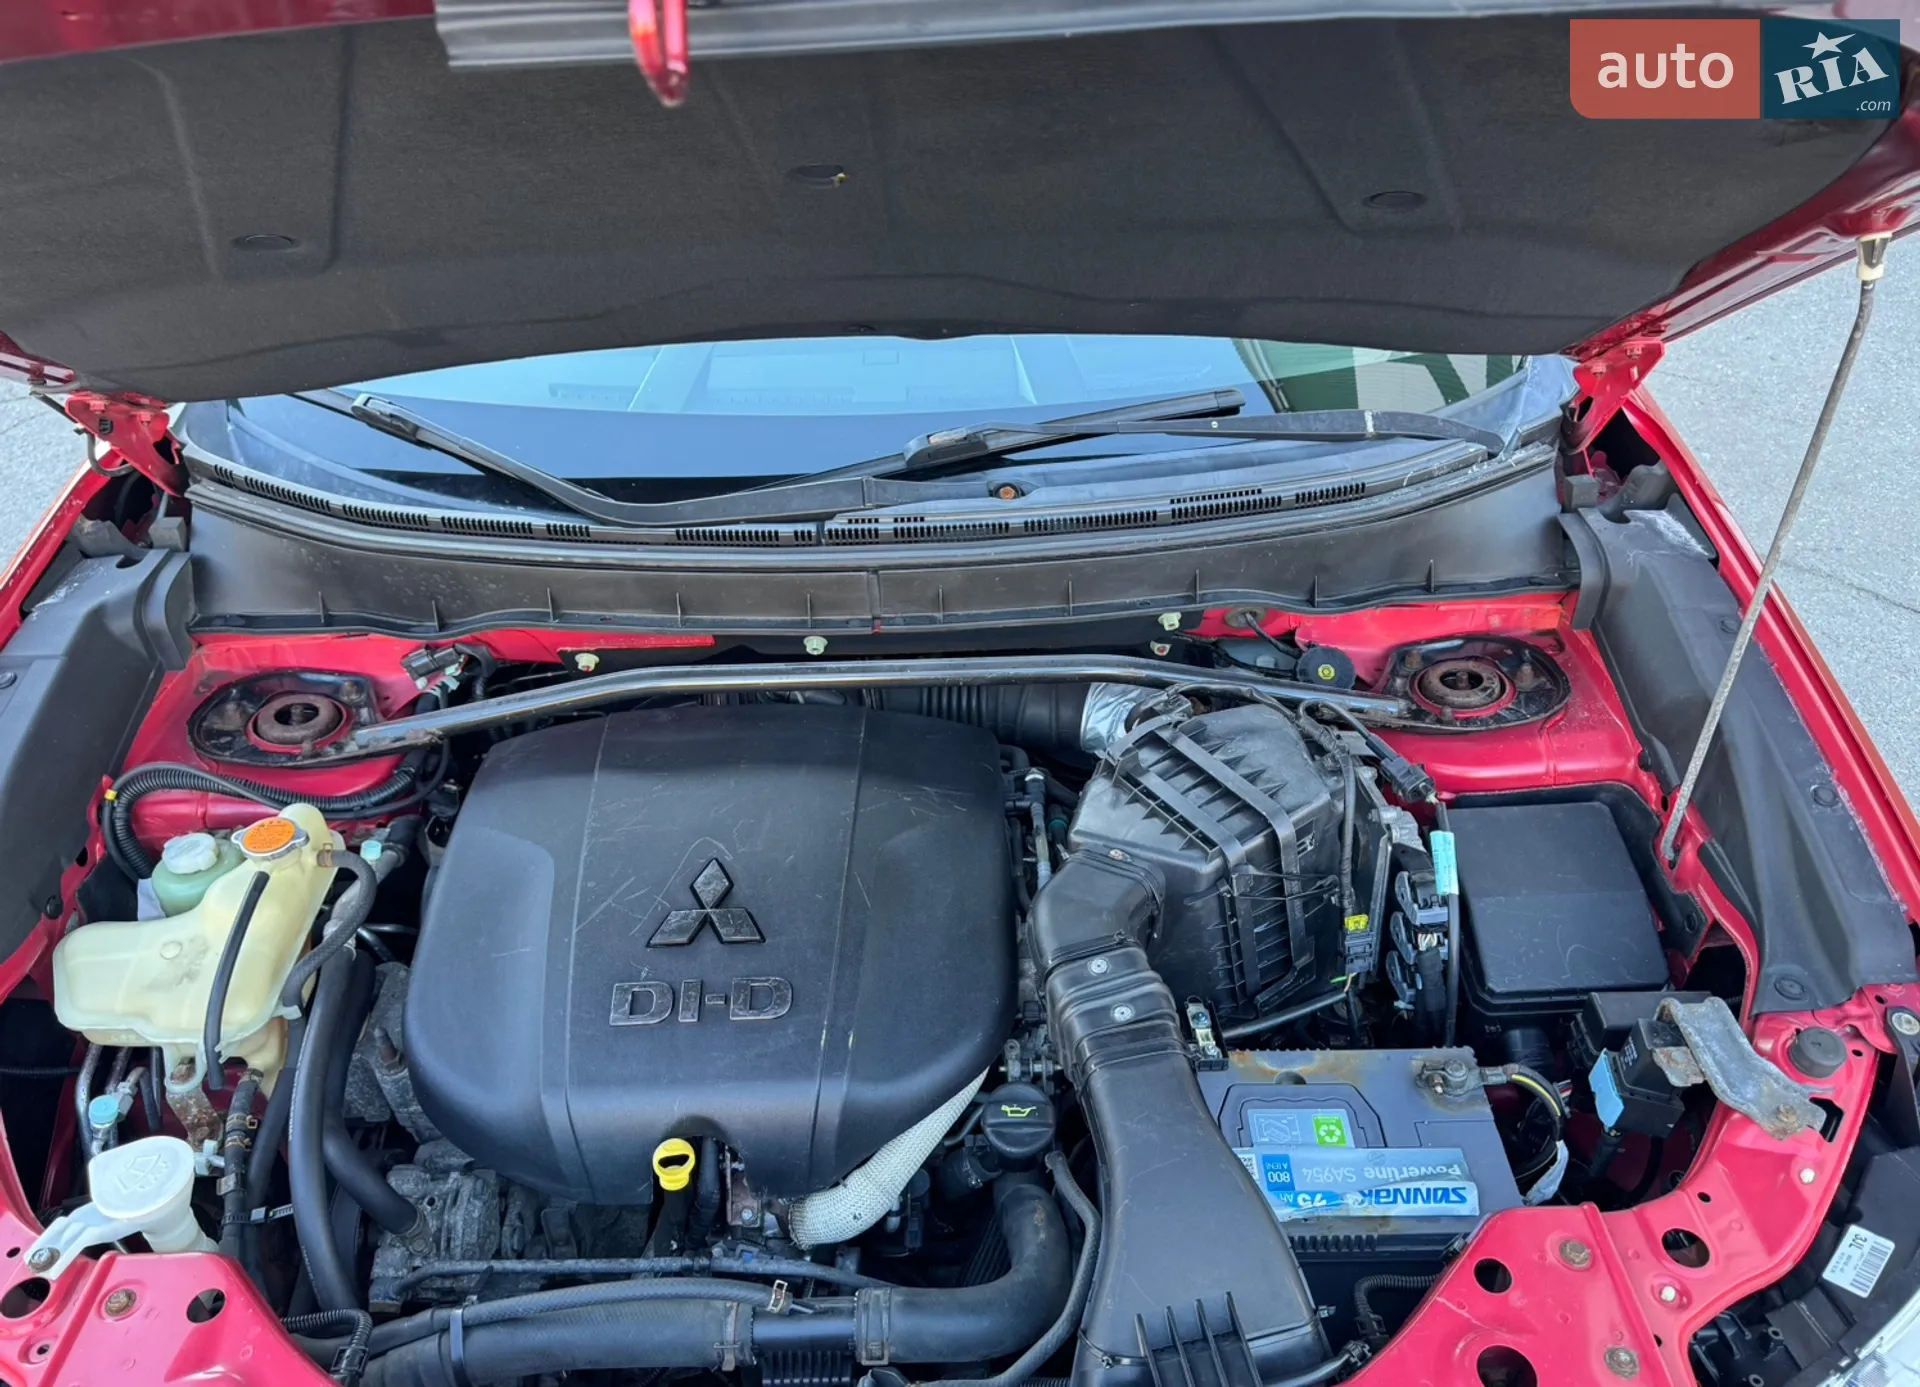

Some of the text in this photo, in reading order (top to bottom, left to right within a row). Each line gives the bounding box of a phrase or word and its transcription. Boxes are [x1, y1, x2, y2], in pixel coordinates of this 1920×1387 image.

[609, 976, 793, 1026] DI-D
[1267, 1171, 1290, 1183] 800
[1302, 1164, 1461, 1183] Powerline SA954
[1297, 1192, 1327, 1209] 75
